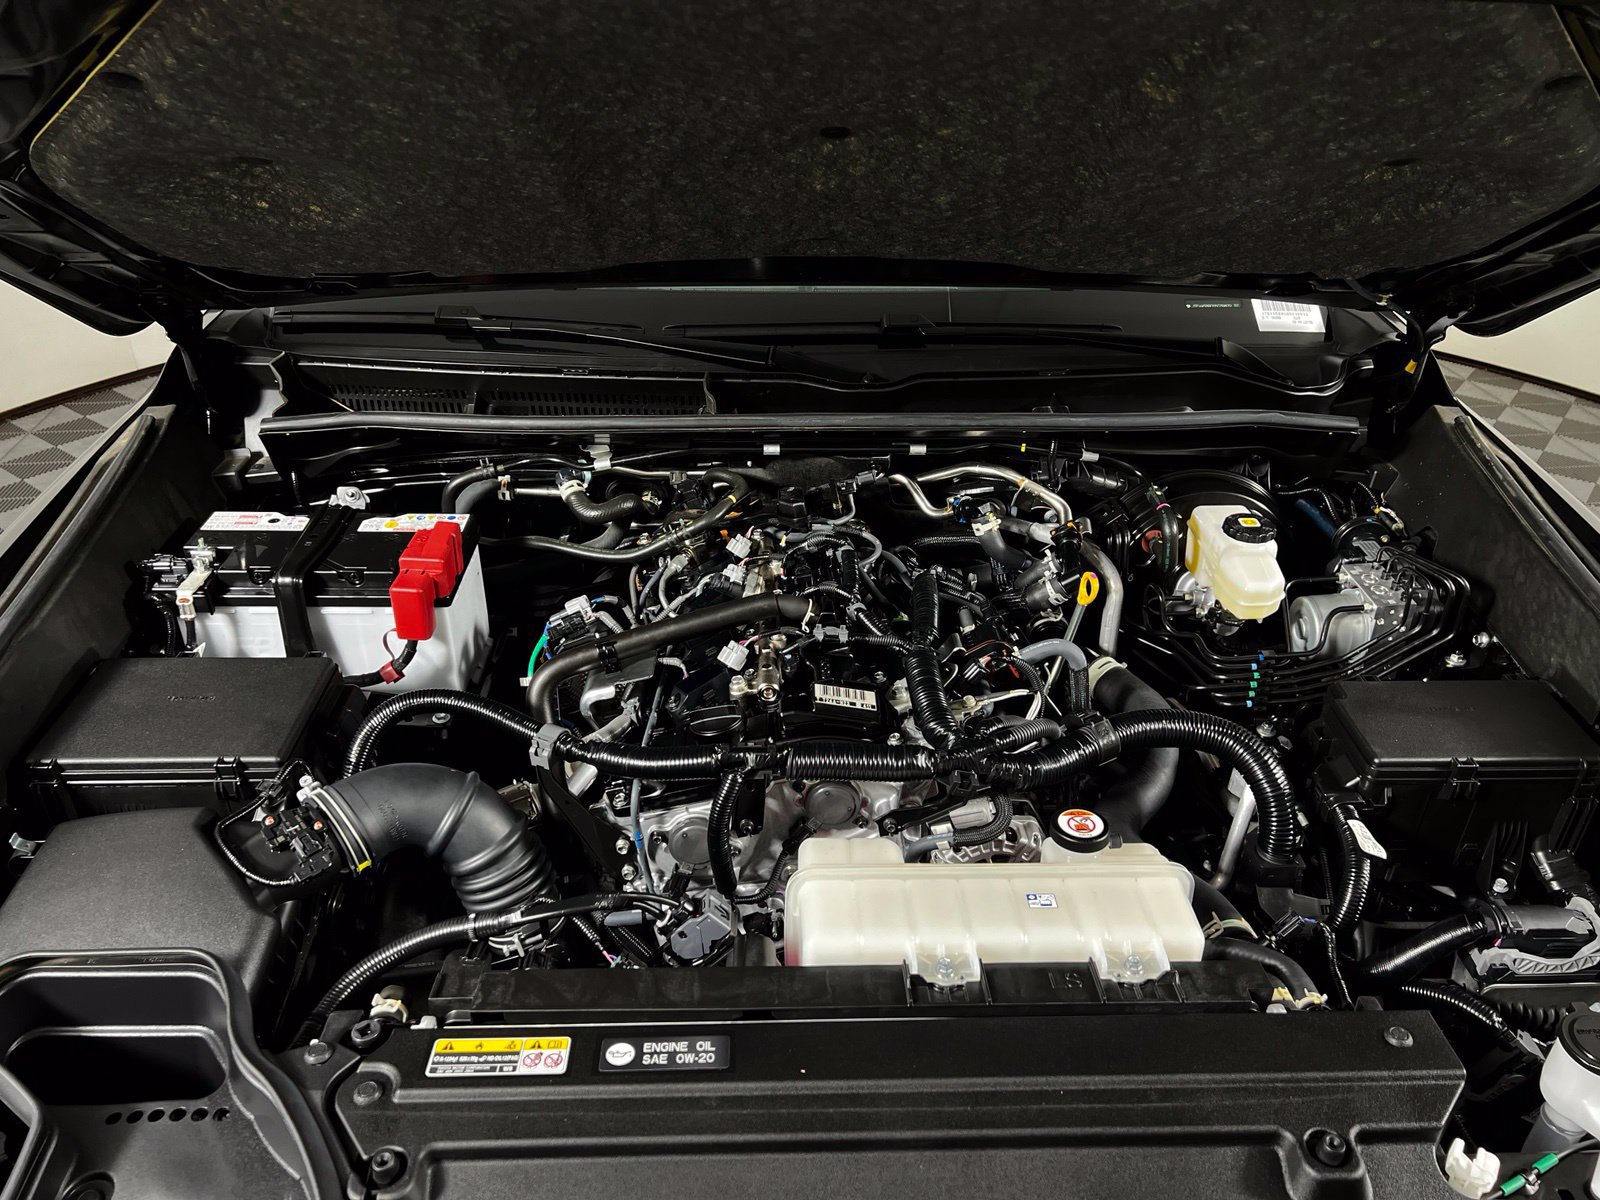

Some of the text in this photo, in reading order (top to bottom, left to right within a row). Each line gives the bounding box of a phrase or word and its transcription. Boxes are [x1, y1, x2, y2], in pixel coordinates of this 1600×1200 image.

[642, 1040, 716, 1053] ENGINE OIL
[641, 1052, 716, 1065] SAE 0W-20
